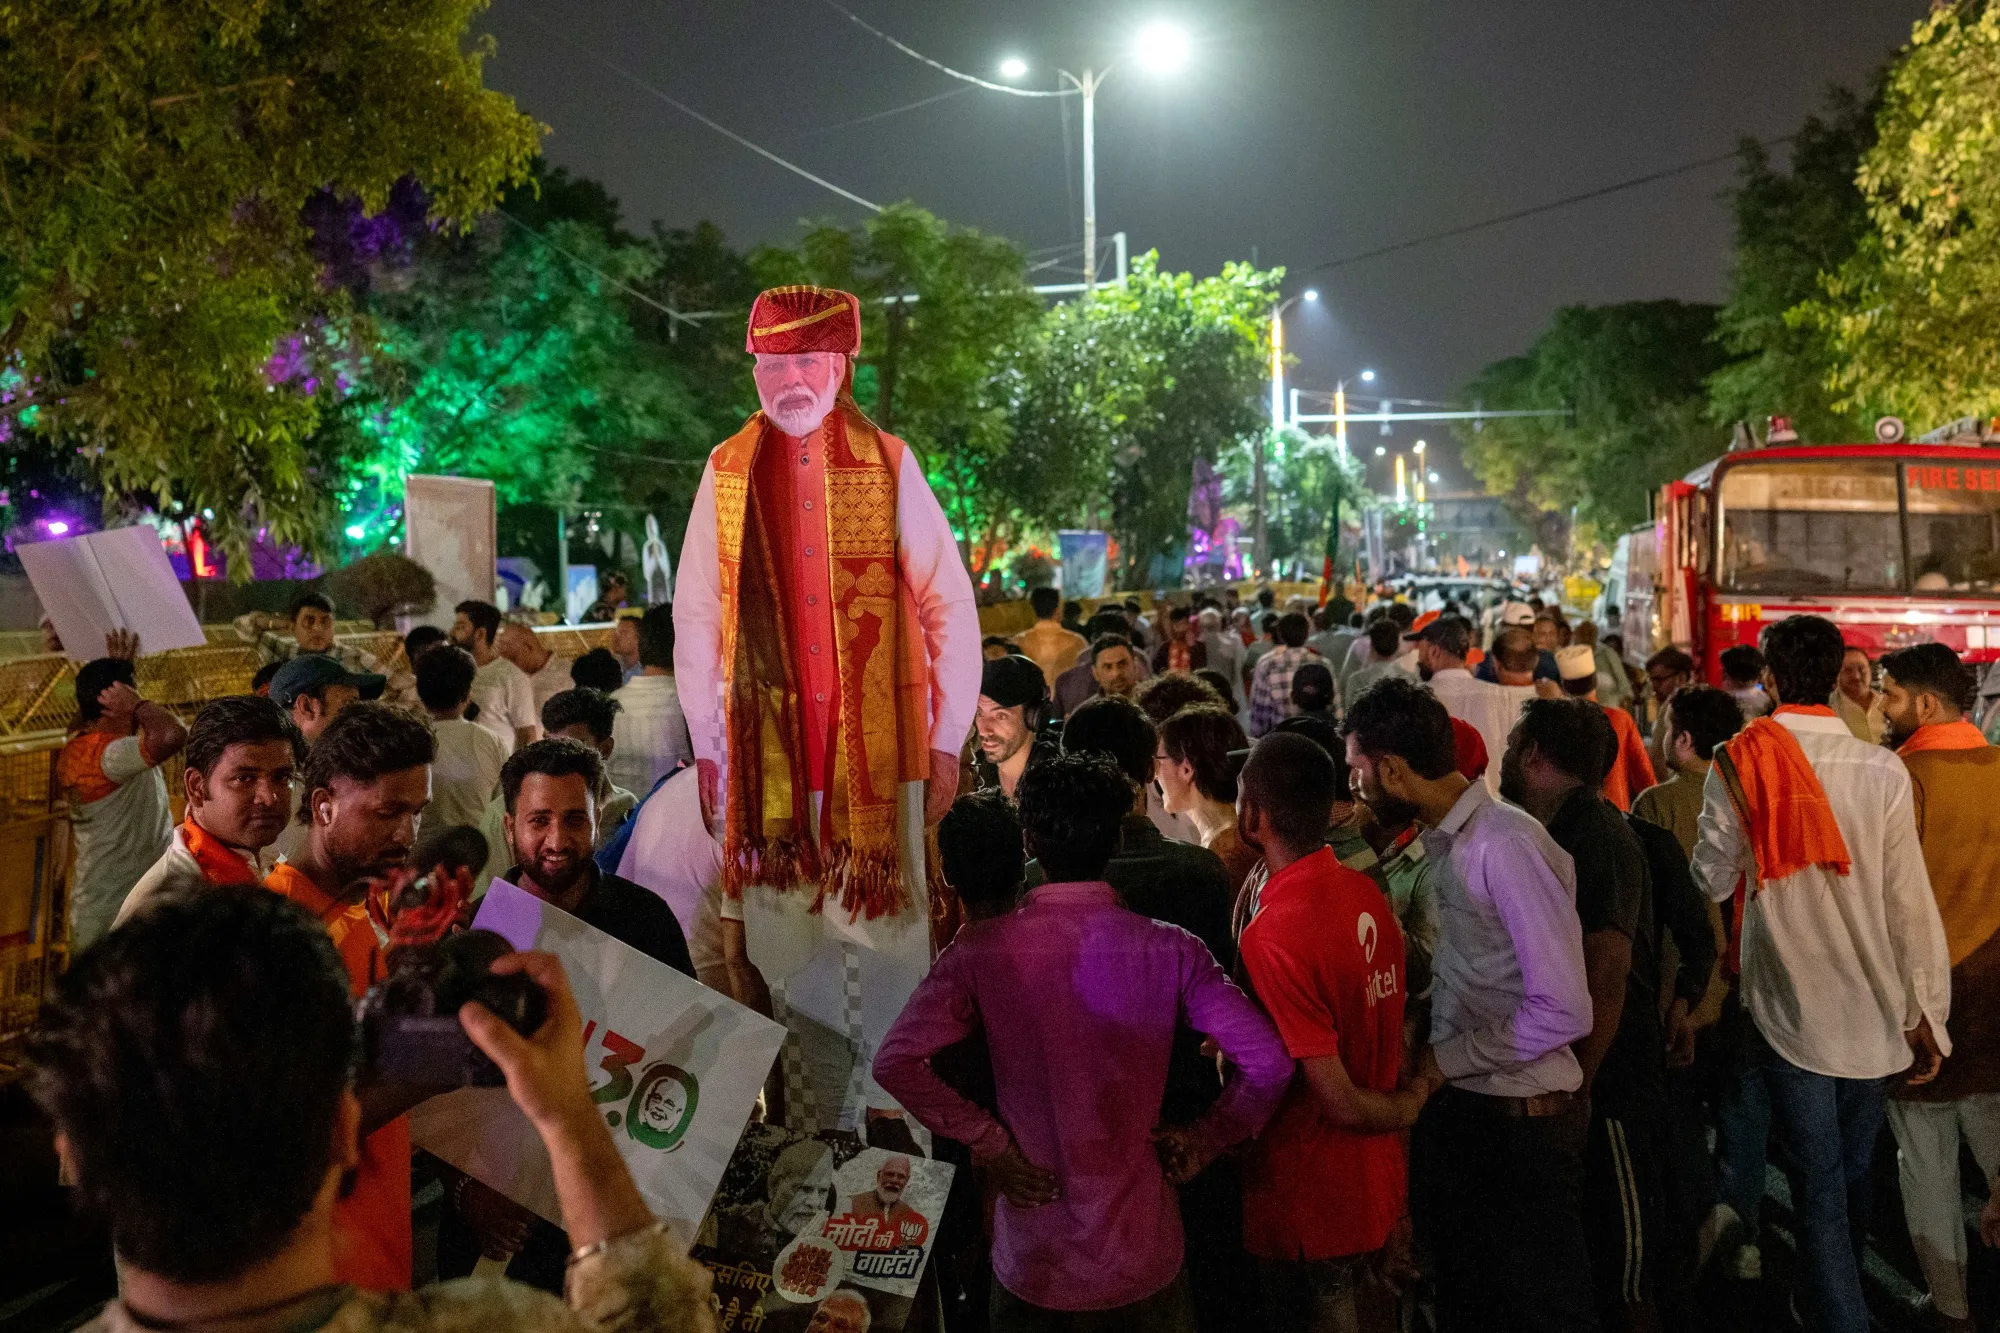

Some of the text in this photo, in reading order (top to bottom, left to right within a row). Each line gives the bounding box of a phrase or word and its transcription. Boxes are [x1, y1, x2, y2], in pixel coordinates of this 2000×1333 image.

[1907, 466, 1960, 489] FIRE
[826, 1217, 895, 1248] मोदी की
[857, 1248, 922, 1275] गारंटी
[704, 1259, 776, 1297] सलिए
